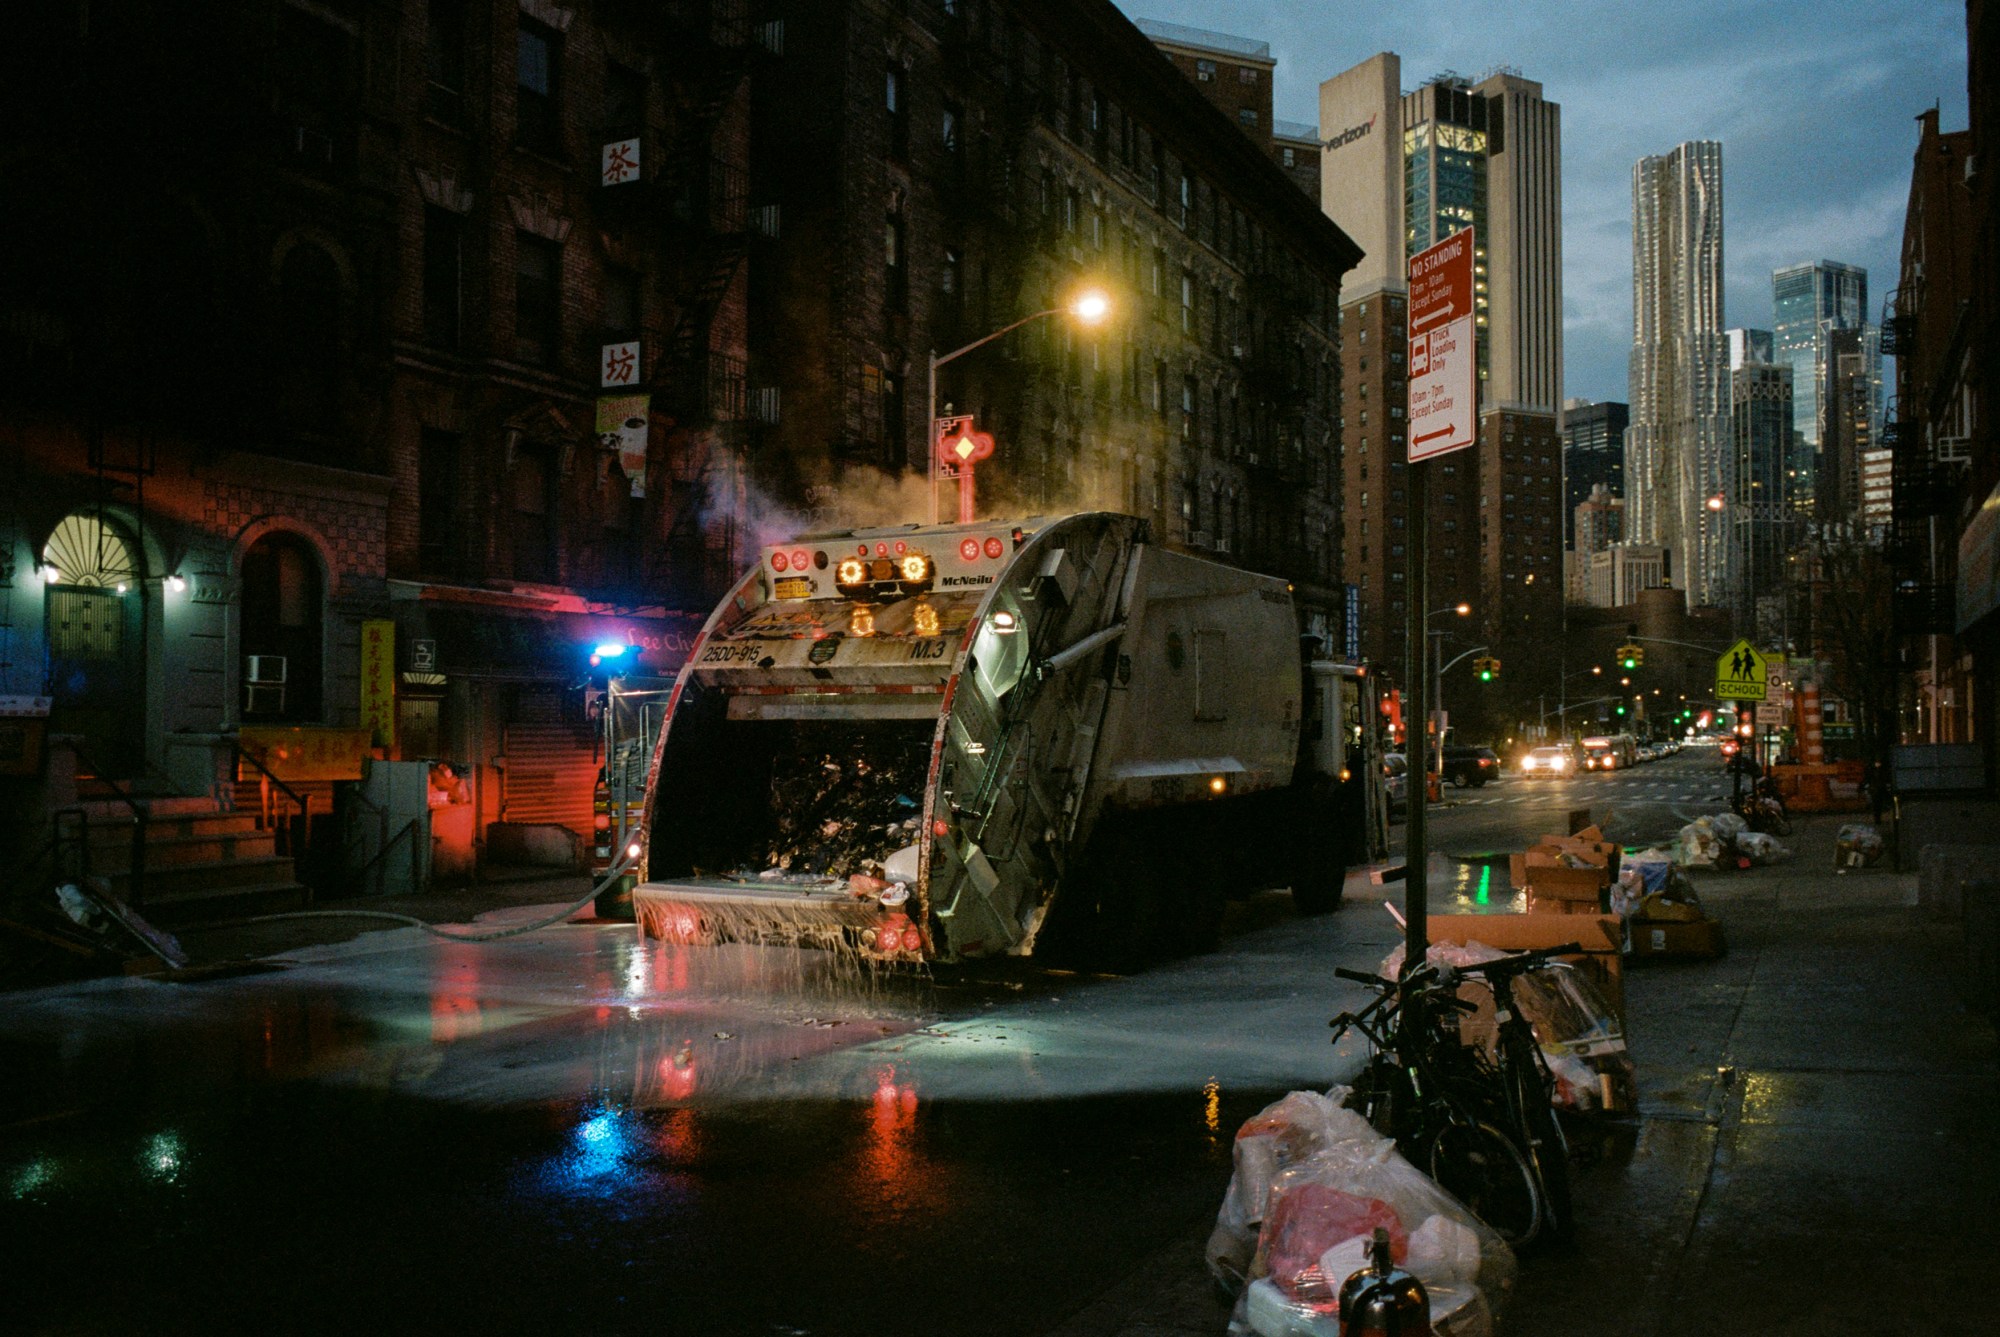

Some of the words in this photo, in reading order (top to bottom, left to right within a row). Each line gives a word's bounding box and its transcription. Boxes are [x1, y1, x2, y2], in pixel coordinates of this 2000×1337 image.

[1326, 122, 1370, 152] verizon
[603, 144, 638, 183] 茶
[1412, 260, 1423, 279] NO
[1424, 240, 1462, 273] STANDING
[1411, 283, 1425, 296] 7am
[1429, 272, 1445, 288] 10am
[1411, 292, 1431, 312] Except
[1431, 283, 1453, 303] Sunday
[1432, 327, 1449, 343] Truck
[1431, 339, 1456, 358] Loading
[606, 347, 636, 383] 坊
[1431, 356, 1446, 372] Only
[1411, 391, 1427, 404] 10am
[1431, 384, 1444, 398] 7pm
[1411, 403, 1431, 419] Except
[1432, 397, 1454, 413] Sunday
[942, 574, 994, 586] McNeilu
[664, 631, 694, 651] Ch
[910, 640, 946, 659] M.3
[703, 646, 762, 663] 25DD-915
[1720, 684, 1763, 695] SCHOOL
